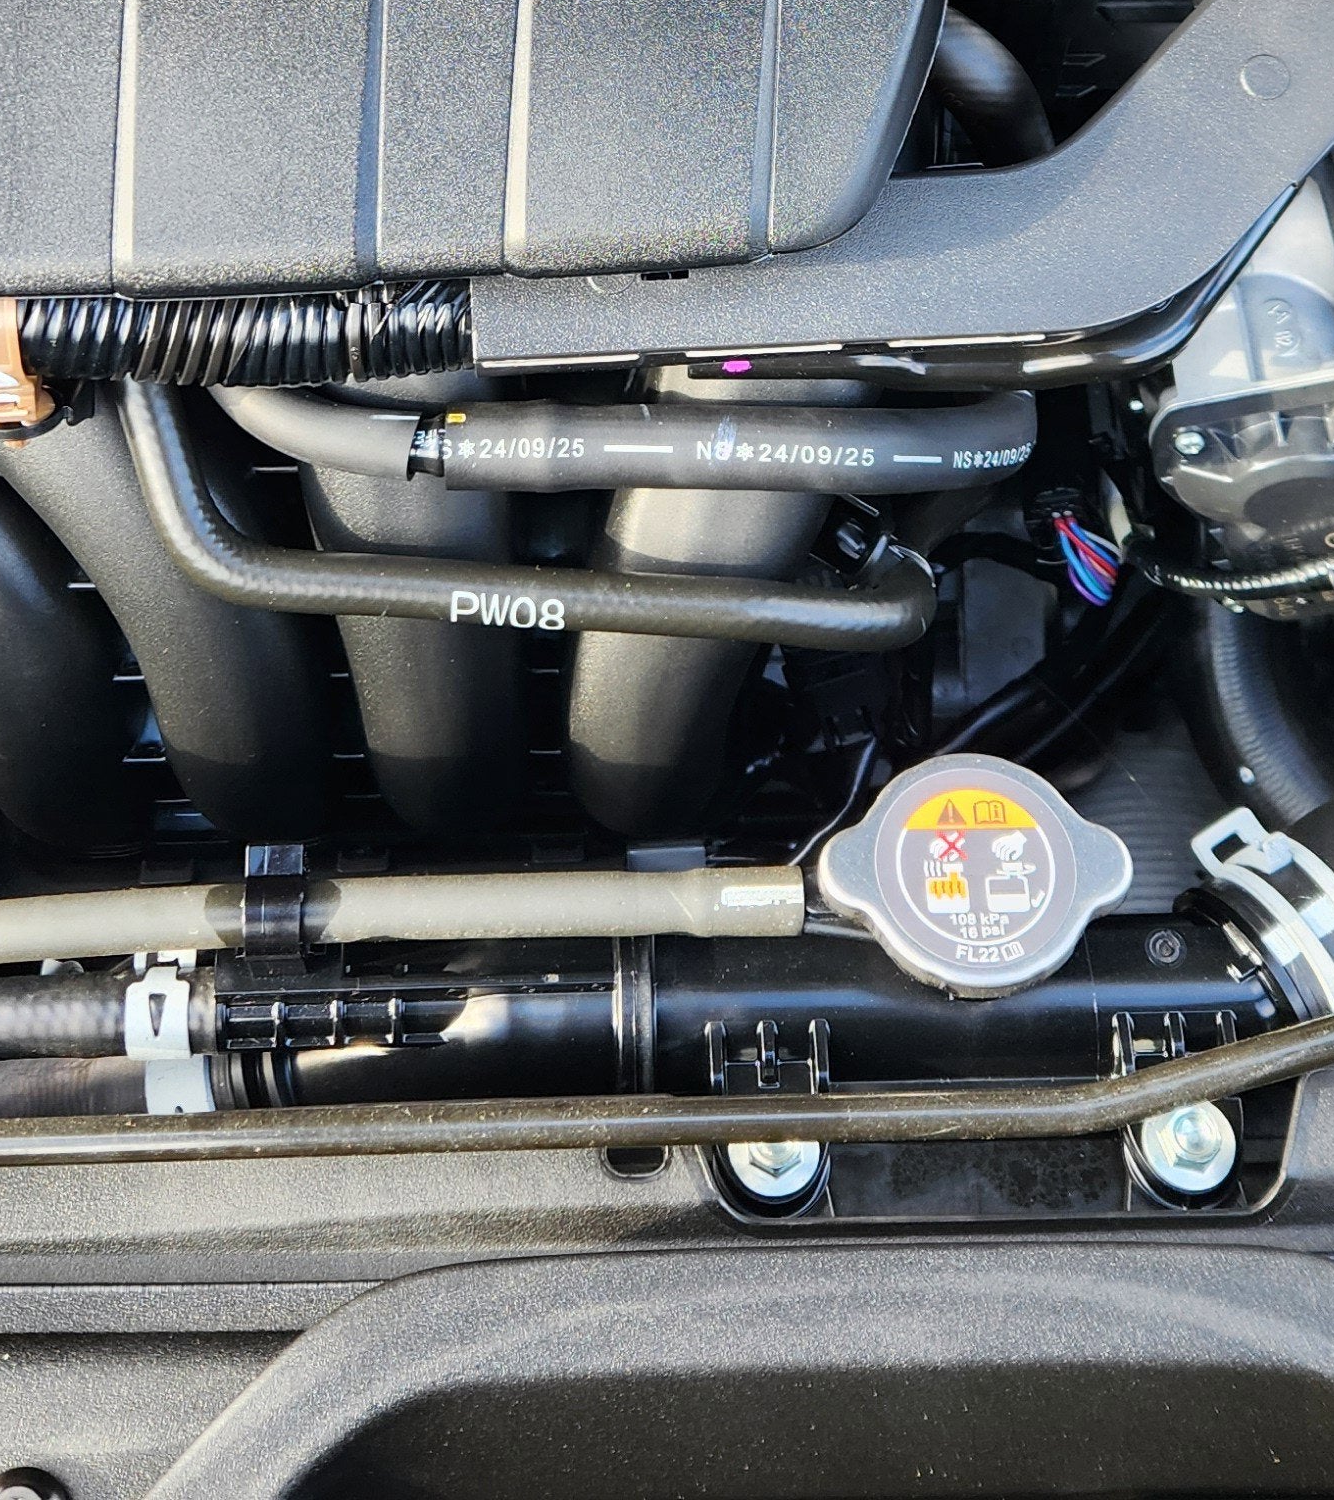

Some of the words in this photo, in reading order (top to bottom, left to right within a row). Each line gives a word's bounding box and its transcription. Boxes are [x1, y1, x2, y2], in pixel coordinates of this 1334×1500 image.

[450, 590, 565, 630] PW08
[949, 913, 977, 926] 108
[979, 912, 1010, 926] kPa
[959, 925, 979, 939] 16
[955, 943, 1001, 963] FL22
